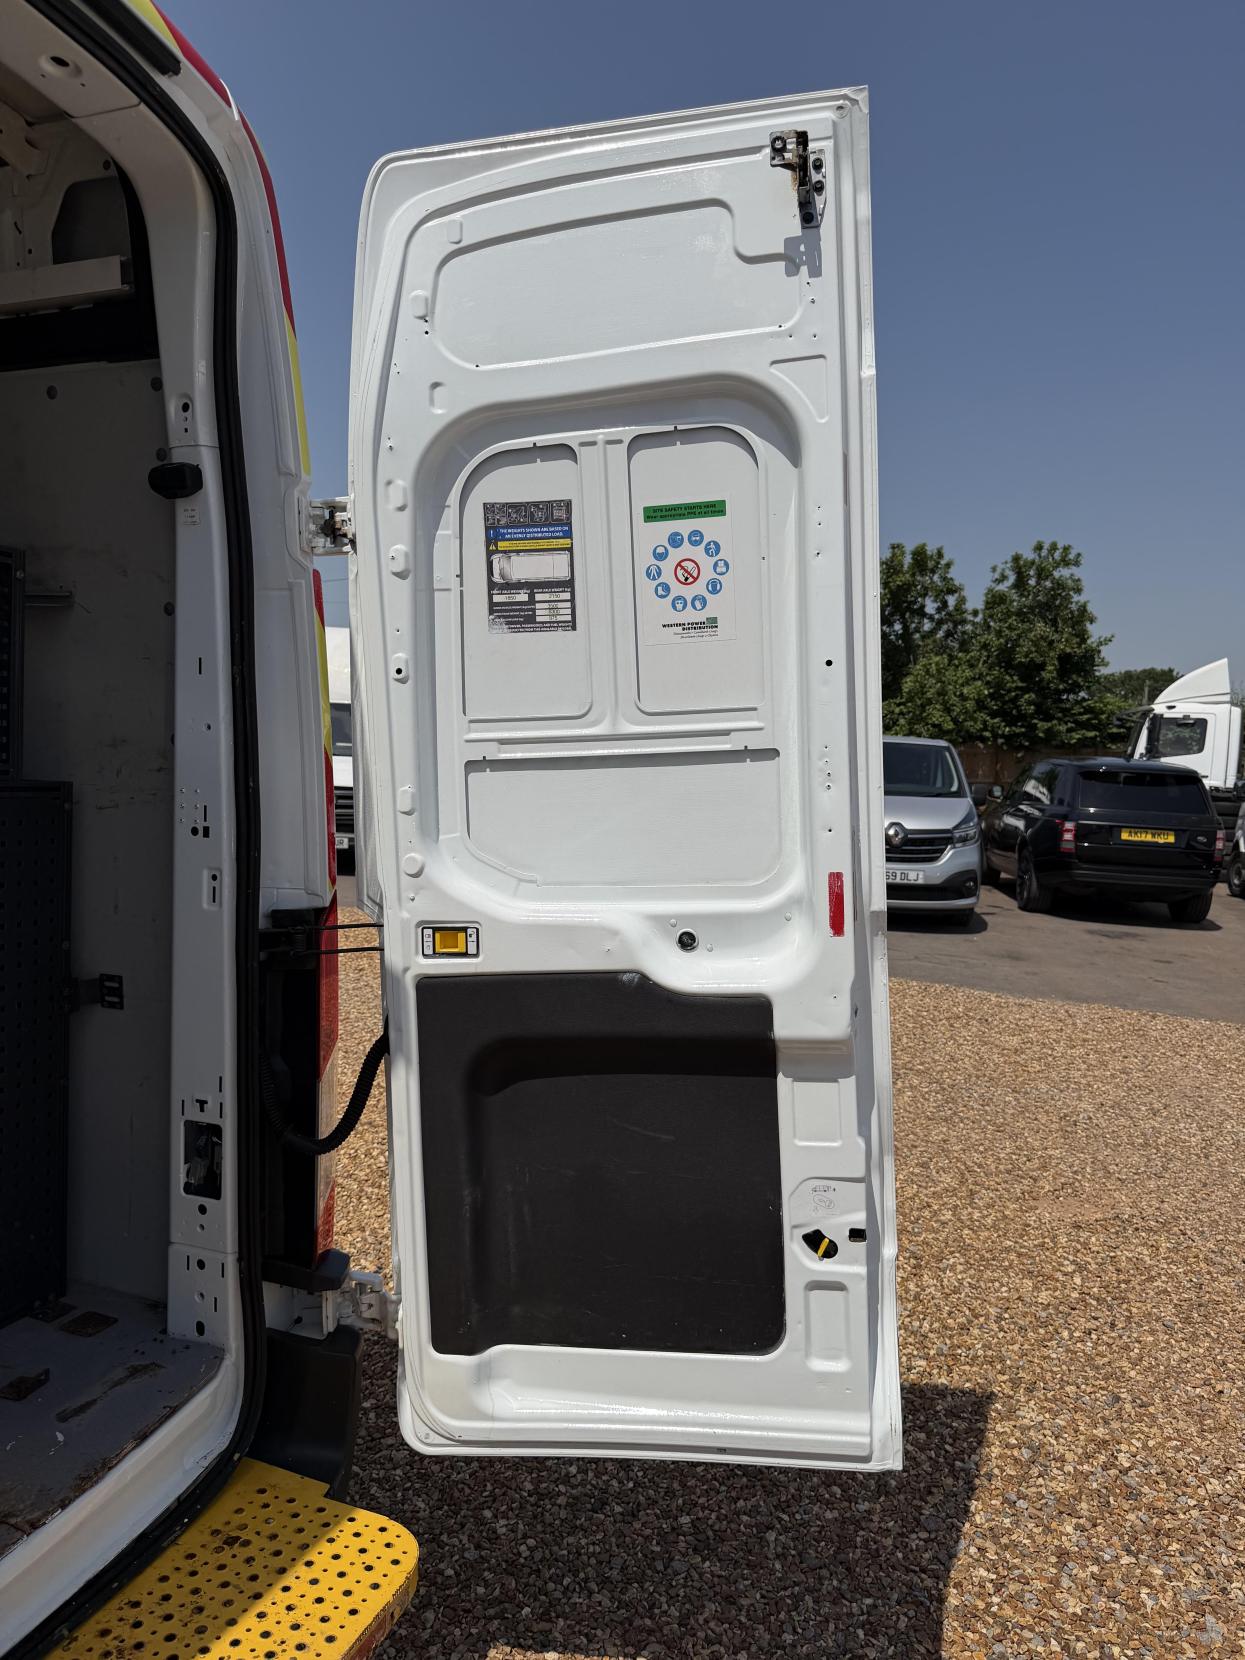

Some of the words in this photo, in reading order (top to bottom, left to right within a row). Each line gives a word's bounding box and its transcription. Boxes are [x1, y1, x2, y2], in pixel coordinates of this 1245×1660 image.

[1128, 830, 1148, 839] AK17
[1151, 832, 1168, 840] WKU
[900, 872, 919, 881] DLJ
